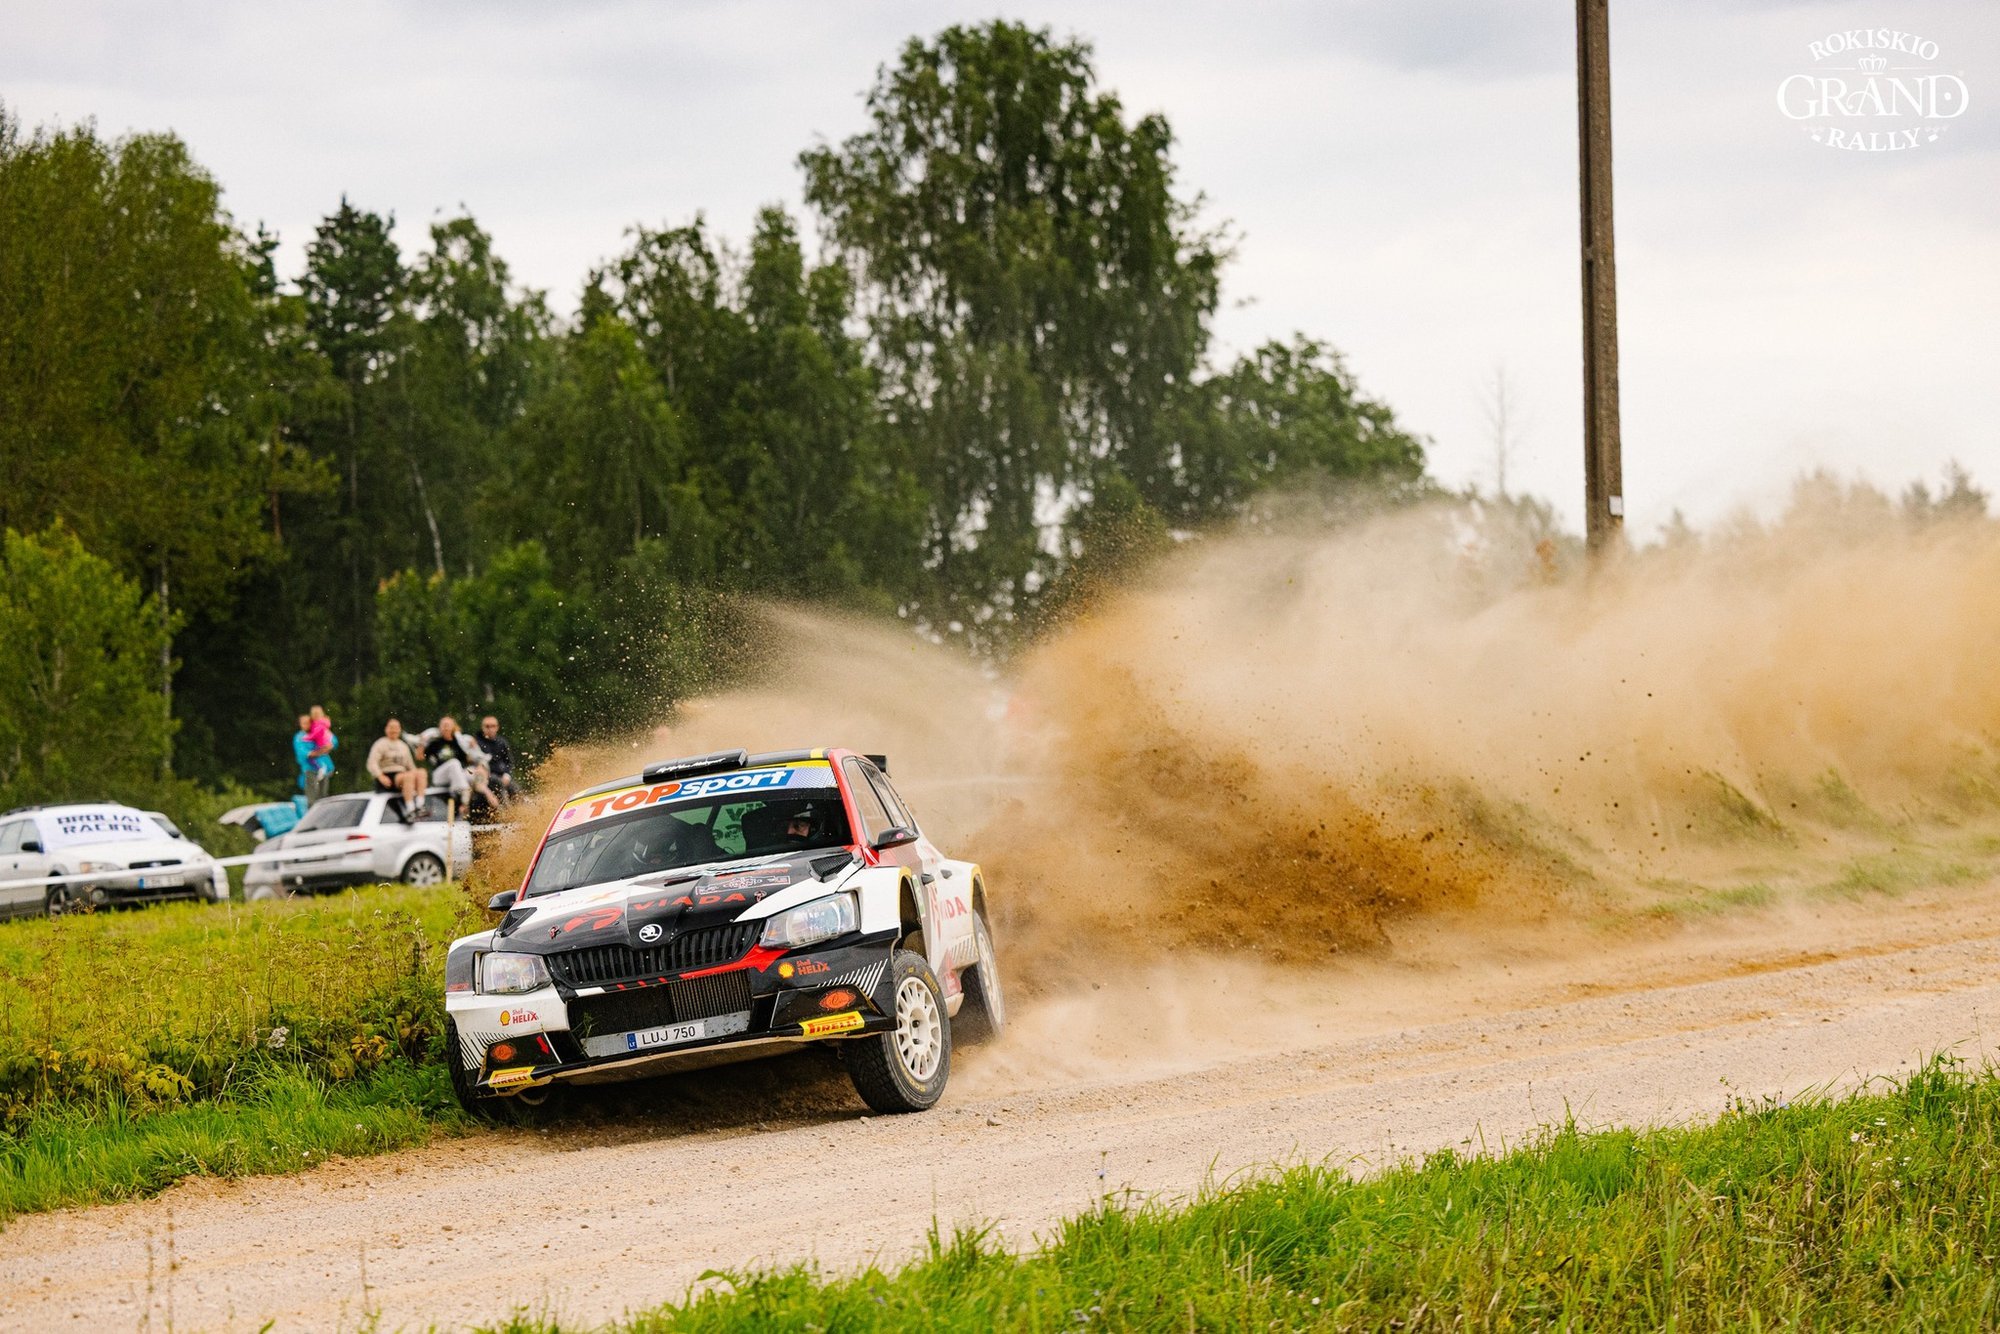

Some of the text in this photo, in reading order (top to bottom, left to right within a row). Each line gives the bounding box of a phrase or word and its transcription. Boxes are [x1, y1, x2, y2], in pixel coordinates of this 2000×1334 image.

[632, 892, 747, 911] VIADA
[797, 962, 830, 976] HELIX
[512, 1012, 539, 1024] HELIX
[808, 1015, 858, 1034] PIRELLI
[641, 1029, 669, 1046] LUJ
[673, 1025, 696, 1040] 750
